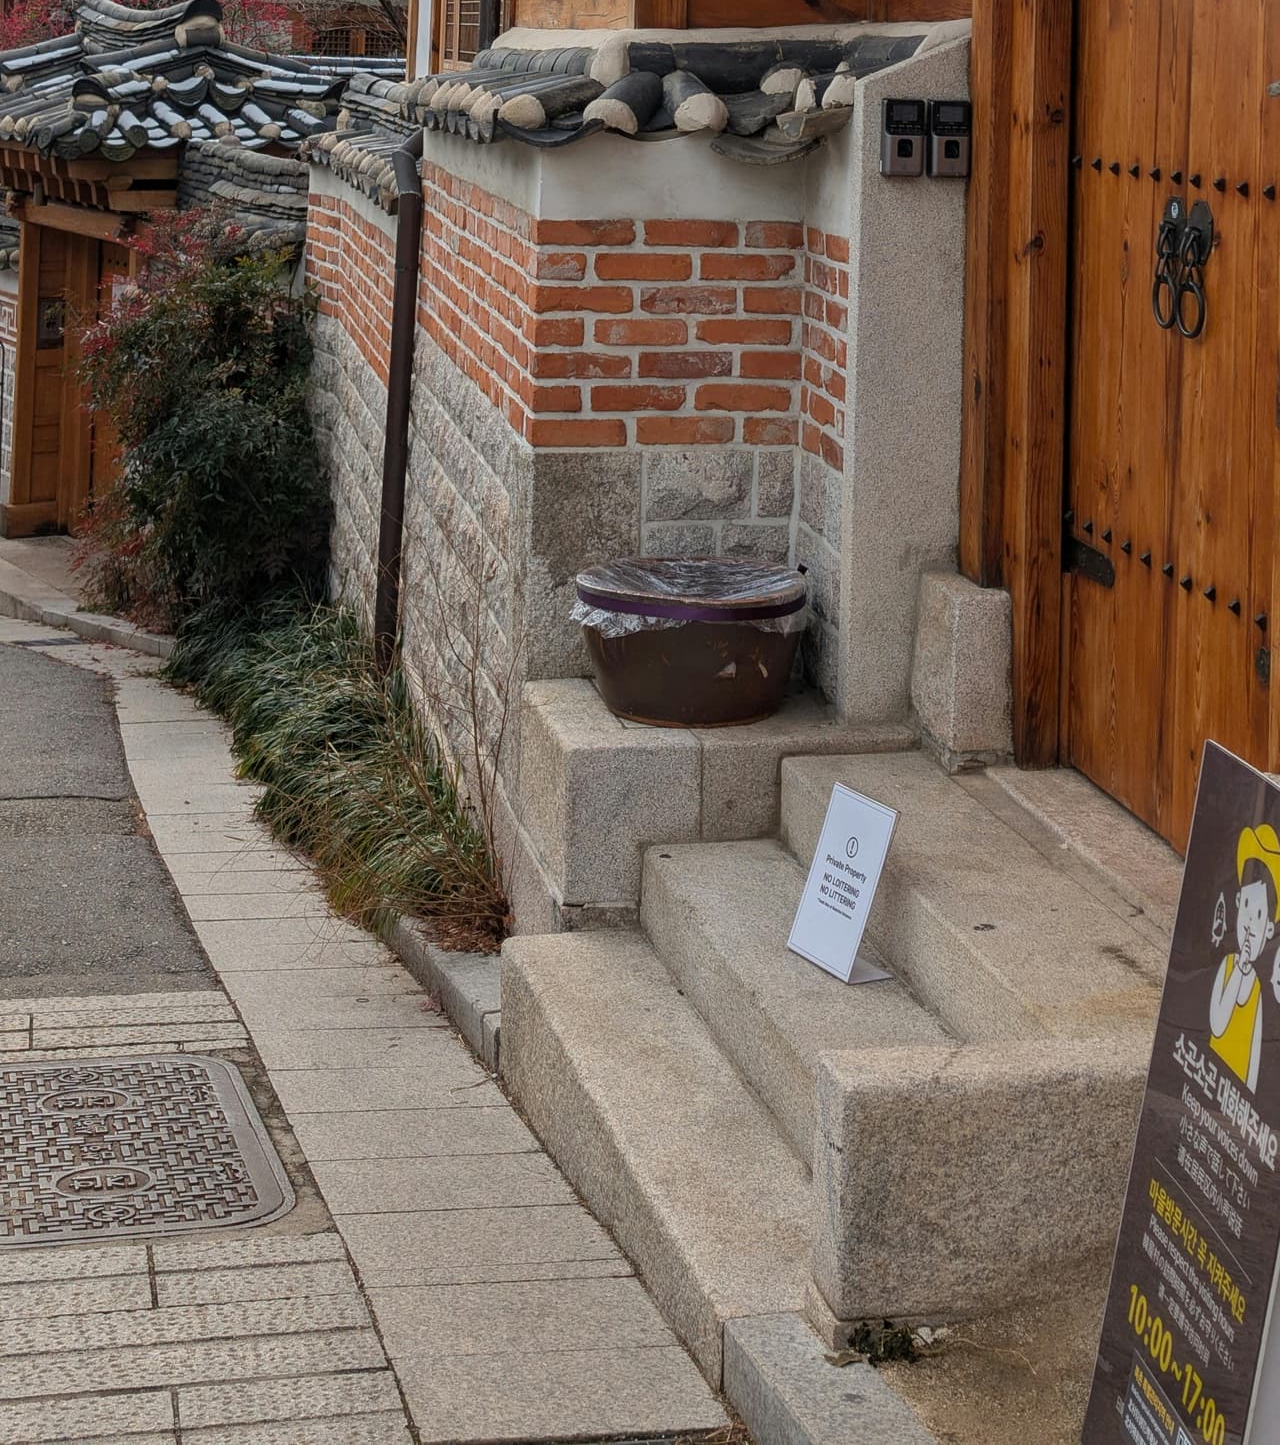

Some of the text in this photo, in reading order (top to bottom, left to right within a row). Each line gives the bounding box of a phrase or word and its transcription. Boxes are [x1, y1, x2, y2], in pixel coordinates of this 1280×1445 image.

[820, 883, 830, 896] NO
[828, 889, 856, 910] LITTERING
[823, 871, 860, 899] NO LOITERING
[826, 853, 867, 884] Private Property
[1173, 1032, 1279, 1172] 소곤소곤 대화해주세요
[1181, 1082, 1258, 1188] Keep your voices down
[1148, 1178, 1246, 1326] 마을방문시간 꼭 지켜주세요
[1149, 1213, 1235, 1344] Please respect the visiting hours
